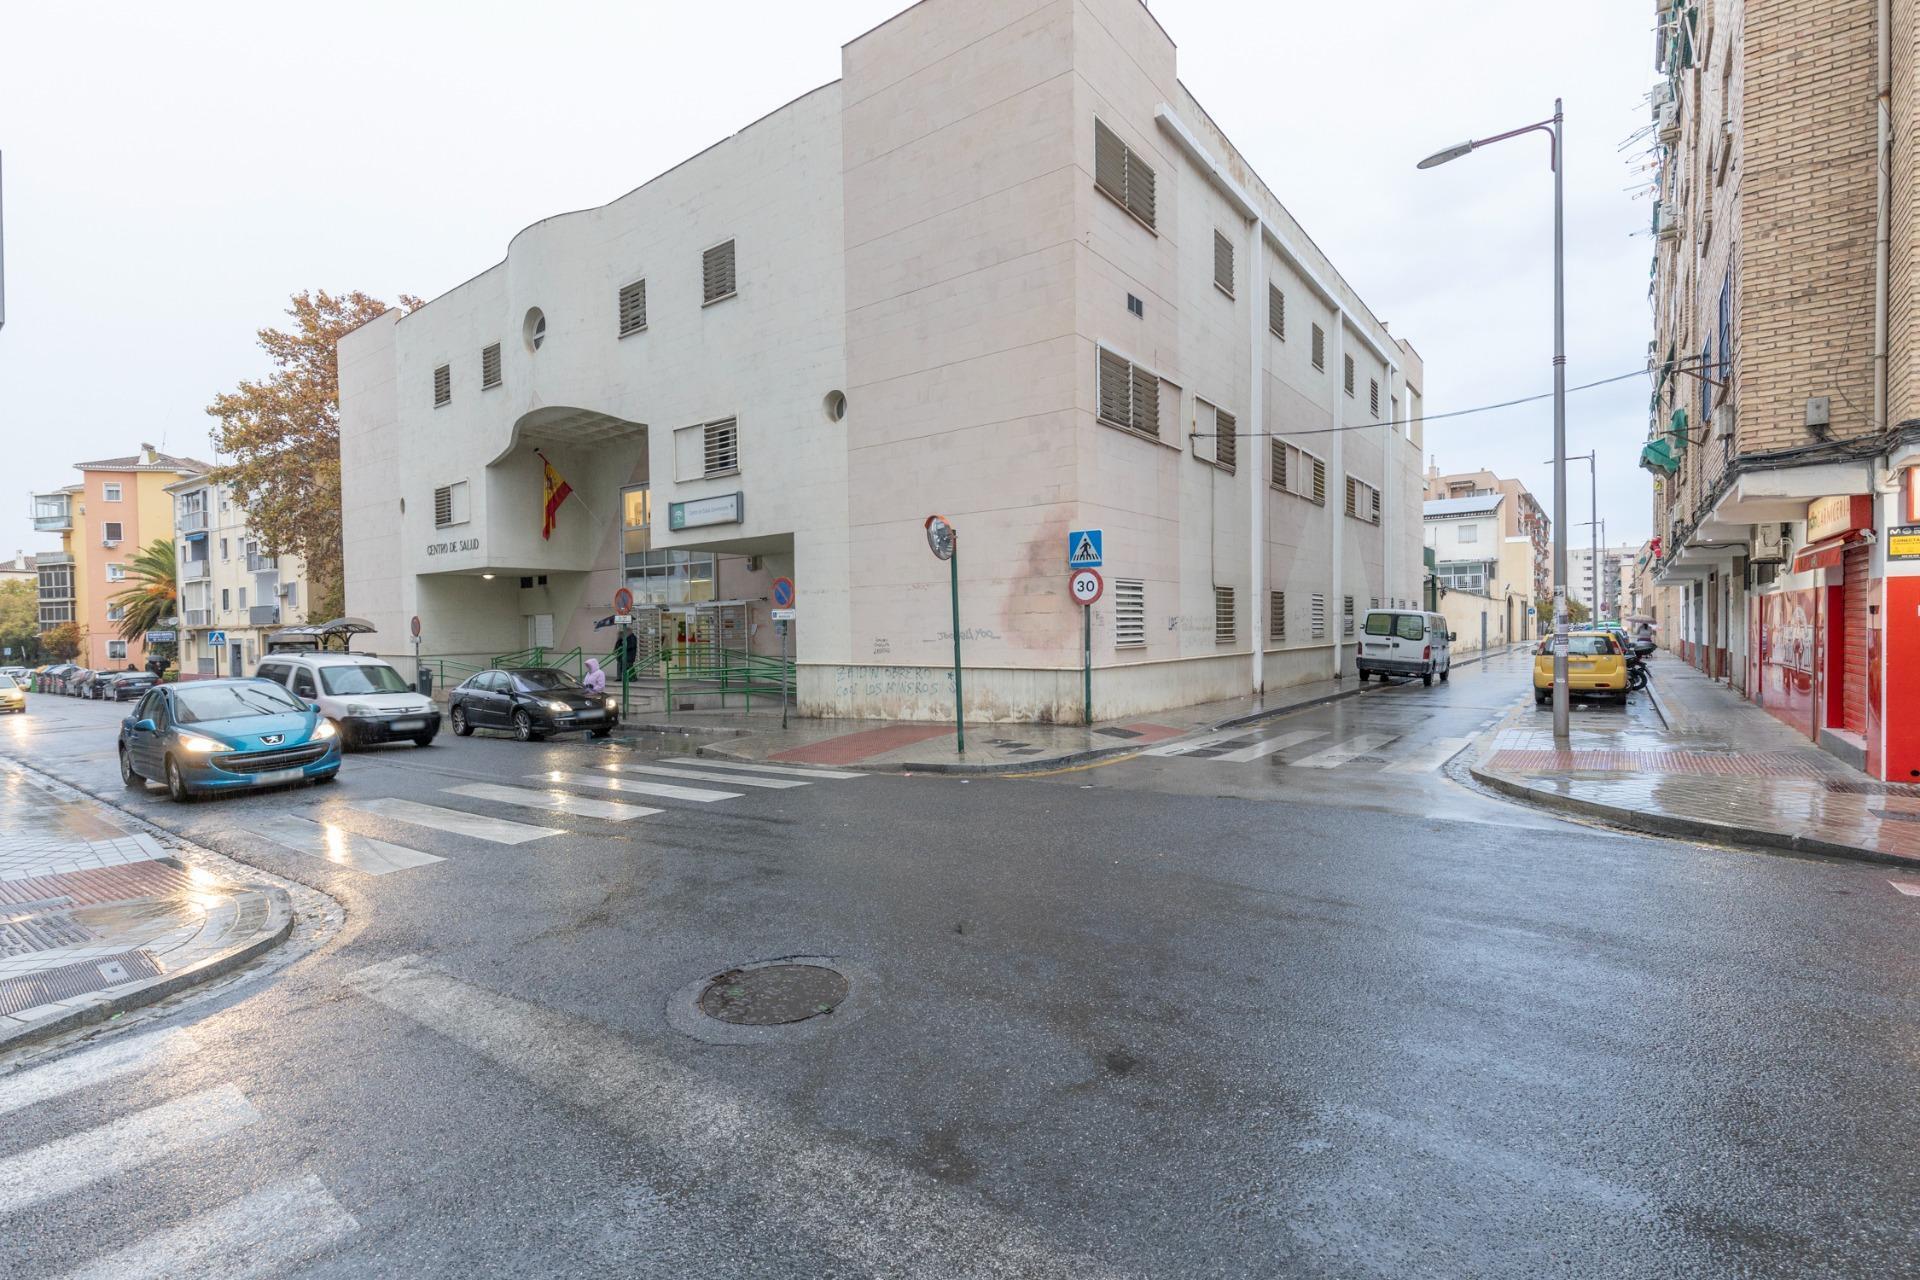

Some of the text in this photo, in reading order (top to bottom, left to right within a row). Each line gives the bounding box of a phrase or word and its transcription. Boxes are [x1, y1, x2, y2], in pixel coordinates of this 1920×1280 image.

[427, 538, 479, 556] CENTRO DE SALUD
[1077, 581, 1095, 592] 30
